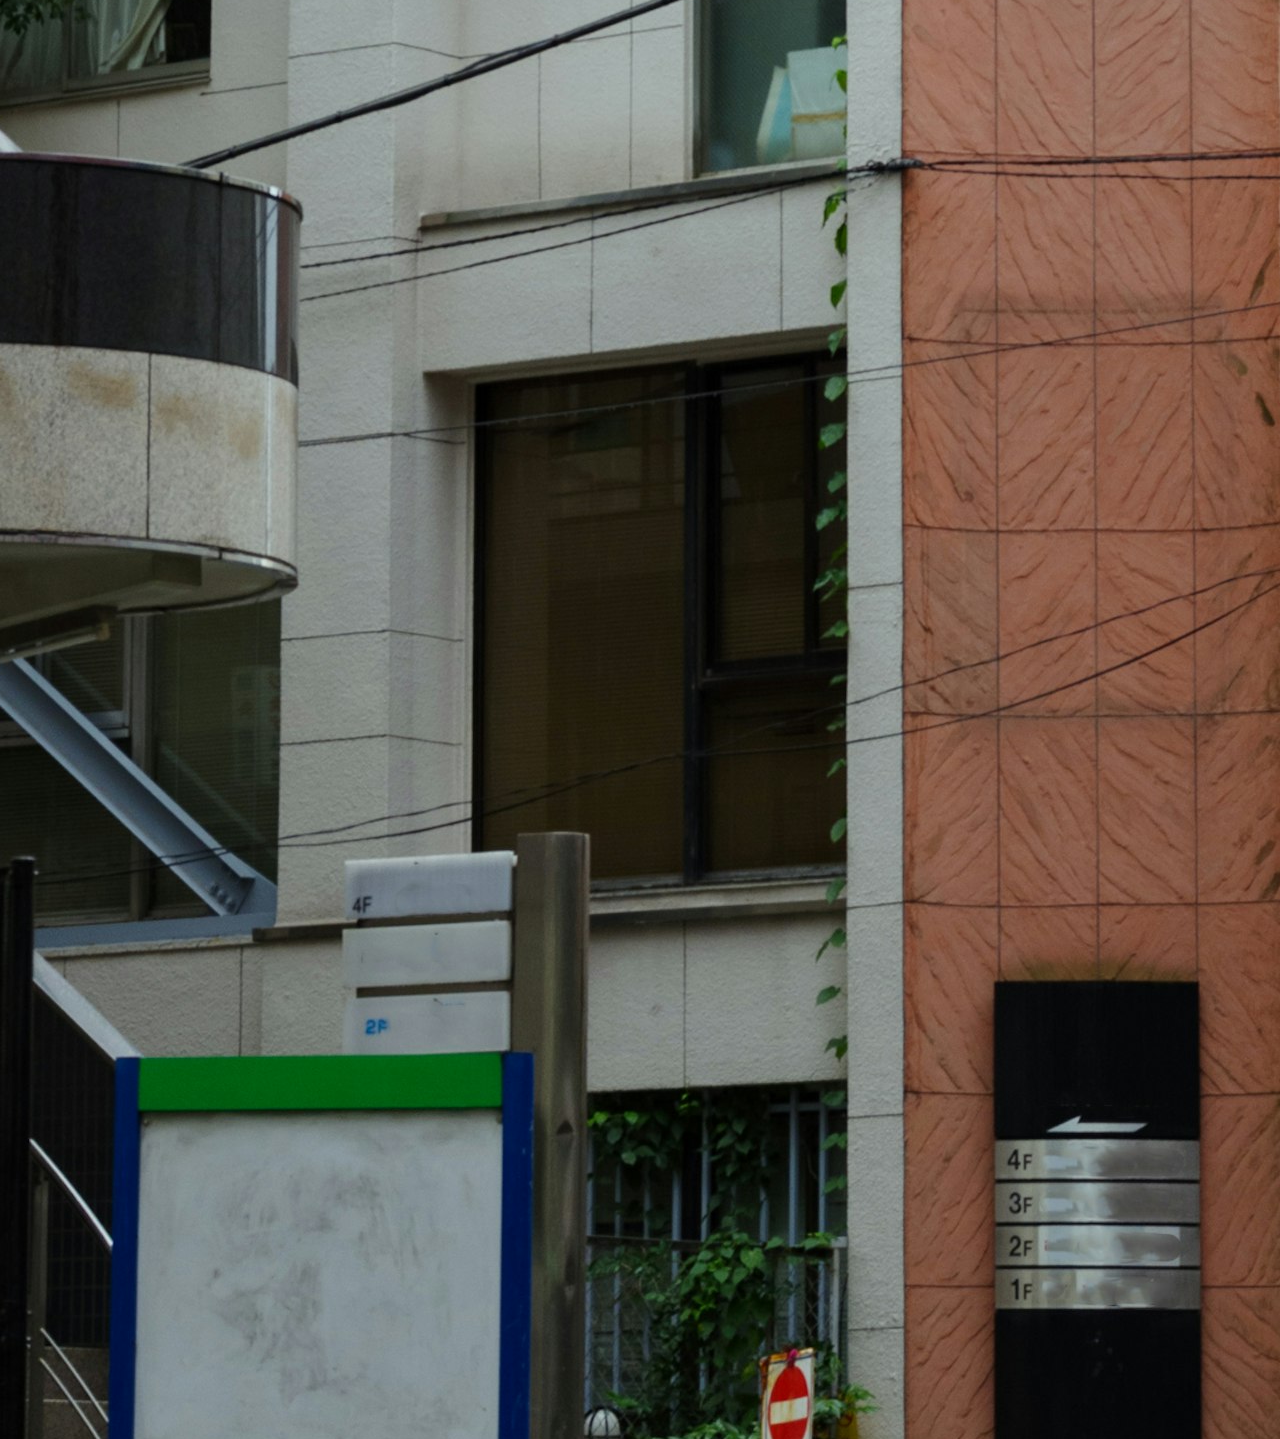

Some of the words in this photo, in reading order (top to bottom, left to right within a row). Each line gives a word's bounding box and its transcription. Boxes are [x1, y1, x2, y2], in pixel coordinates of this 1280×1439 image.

[352, 896, 373, 914] 4F
[365, 1019, 389, 1035] 2F
[1007, 1149, 1033, 1171] 4F
[1008, 1192, 1033, 1214] 3F
[1008, 1235, 1033, 1257] 2F
[1011, 1278, 1033, 1300] 1F
